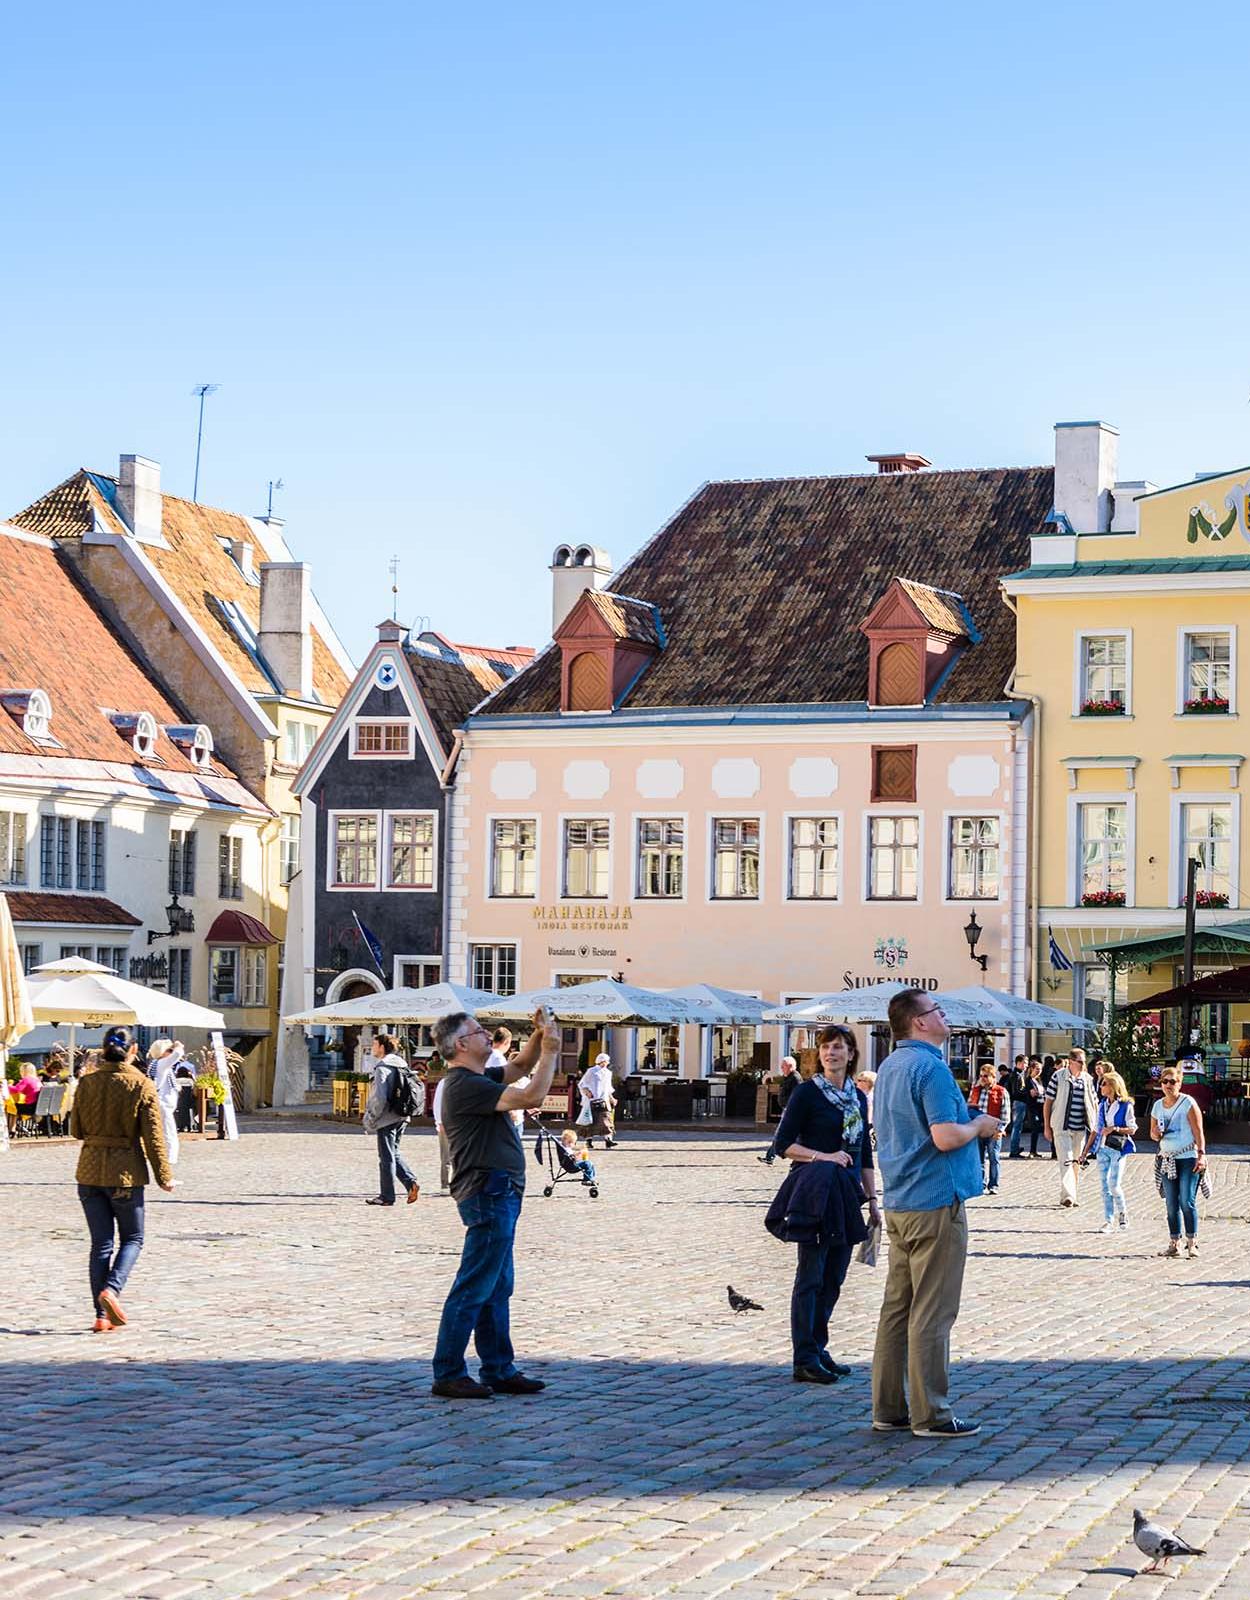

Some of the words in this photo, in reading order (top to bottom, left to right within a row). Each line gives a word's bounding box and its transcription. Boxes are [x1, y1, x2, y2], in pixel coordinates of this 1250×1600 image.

[533, 906, 633, 919] MAHARAJA
[538, 922, 567, 930] INDIA
[571, 922, 629, 930] RESTORAN
